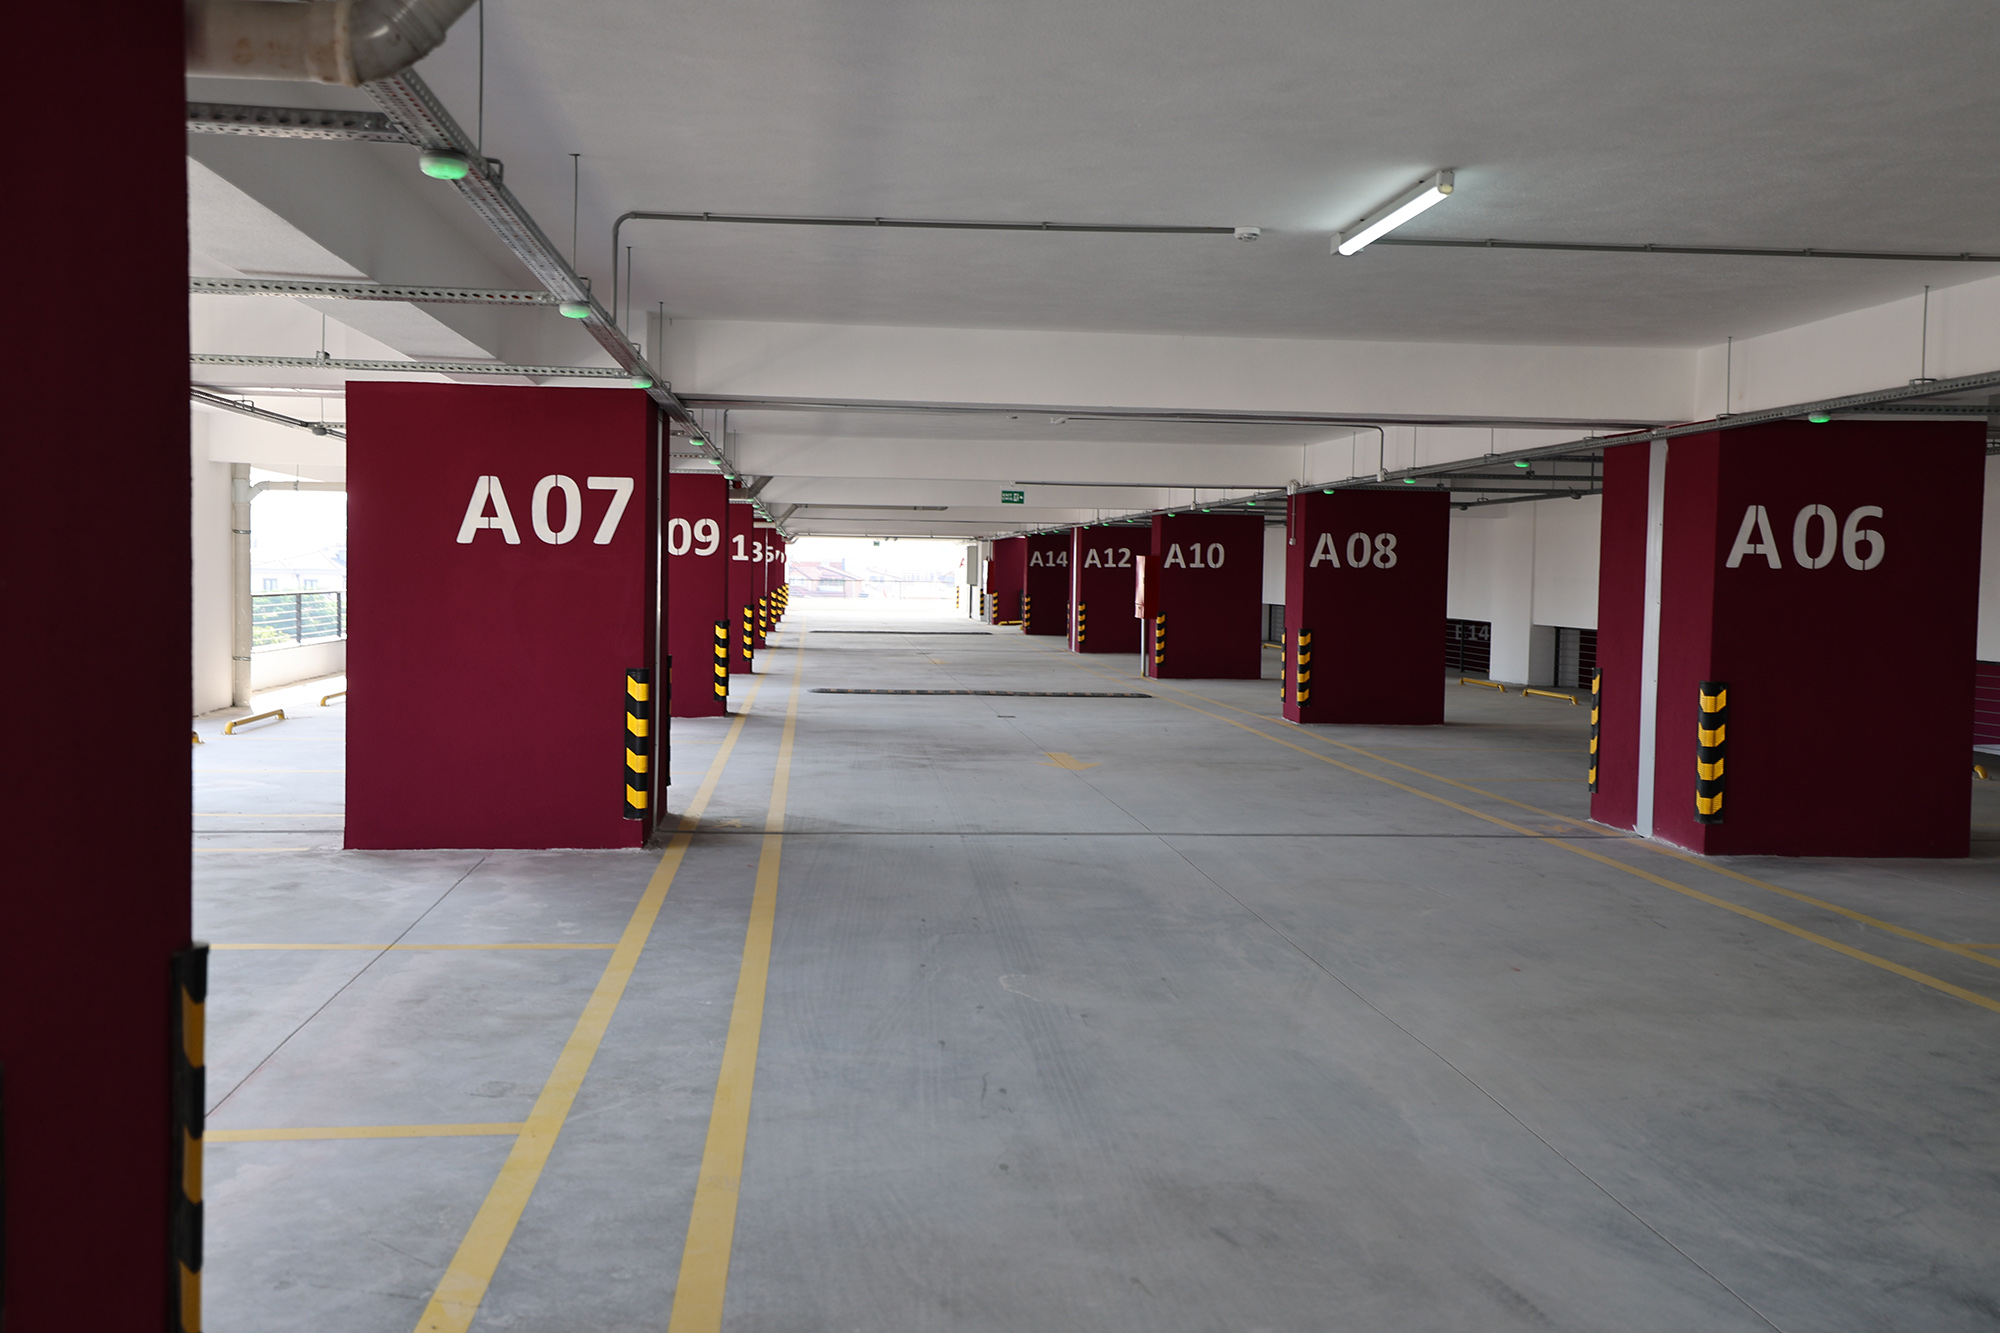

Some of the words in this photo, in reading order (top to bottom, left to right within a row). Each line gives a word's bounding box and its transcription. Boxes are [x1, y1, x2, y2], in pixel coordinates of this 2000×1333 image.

[1029, 551, 1068, 567] A14
[1084, 548, 1132, 568] A12
[1163, 543, 1225, 569] A10
